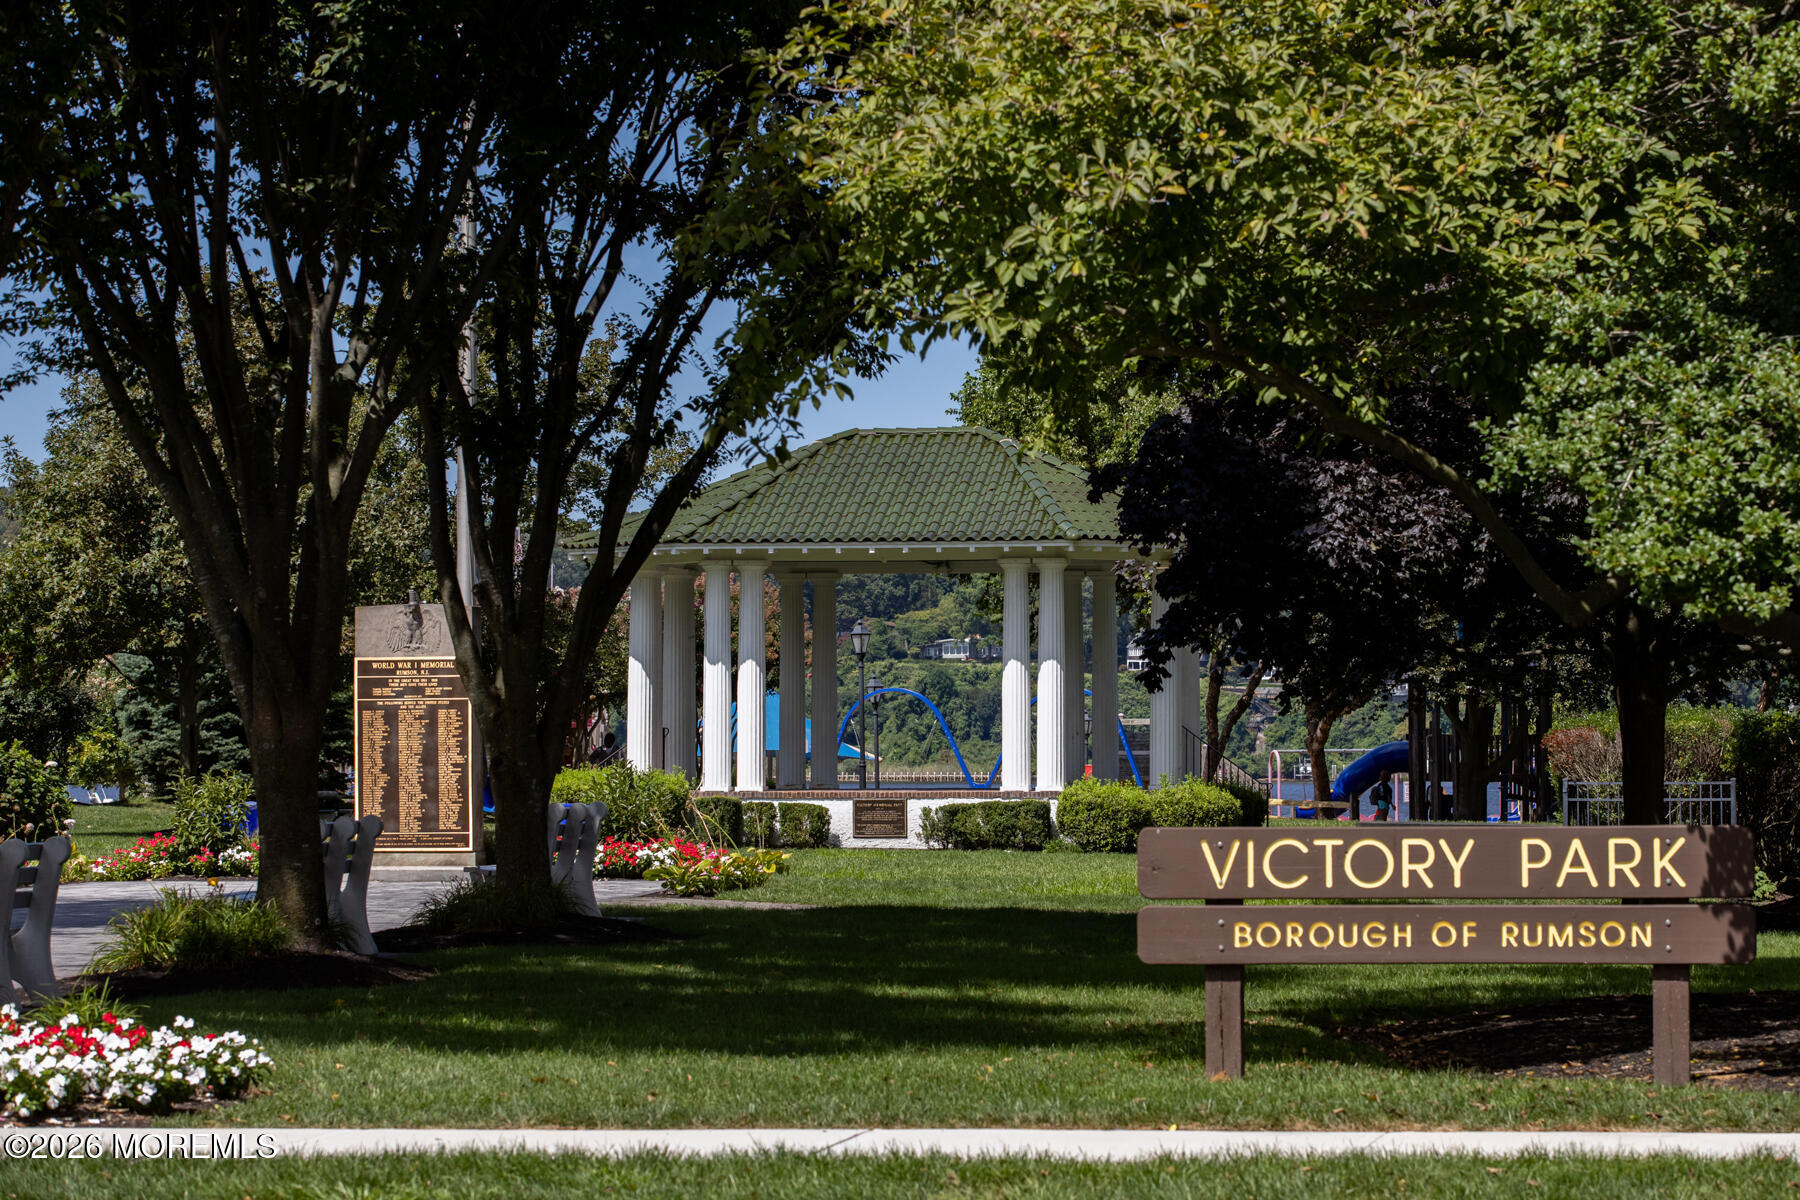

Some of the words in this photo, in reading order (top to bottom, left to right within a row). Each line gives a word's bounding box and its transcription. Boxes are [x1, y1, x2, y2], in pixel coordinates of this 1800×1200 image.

[1200, 838, 1476, 890] VICTORY
[1520, 836, 1688, 888] PARK
[1234, 923, 1412, 949] BOROUGH
[1430, 923, 1478, 948] OF
[1501, 923, 1653, 948] RUMSON
